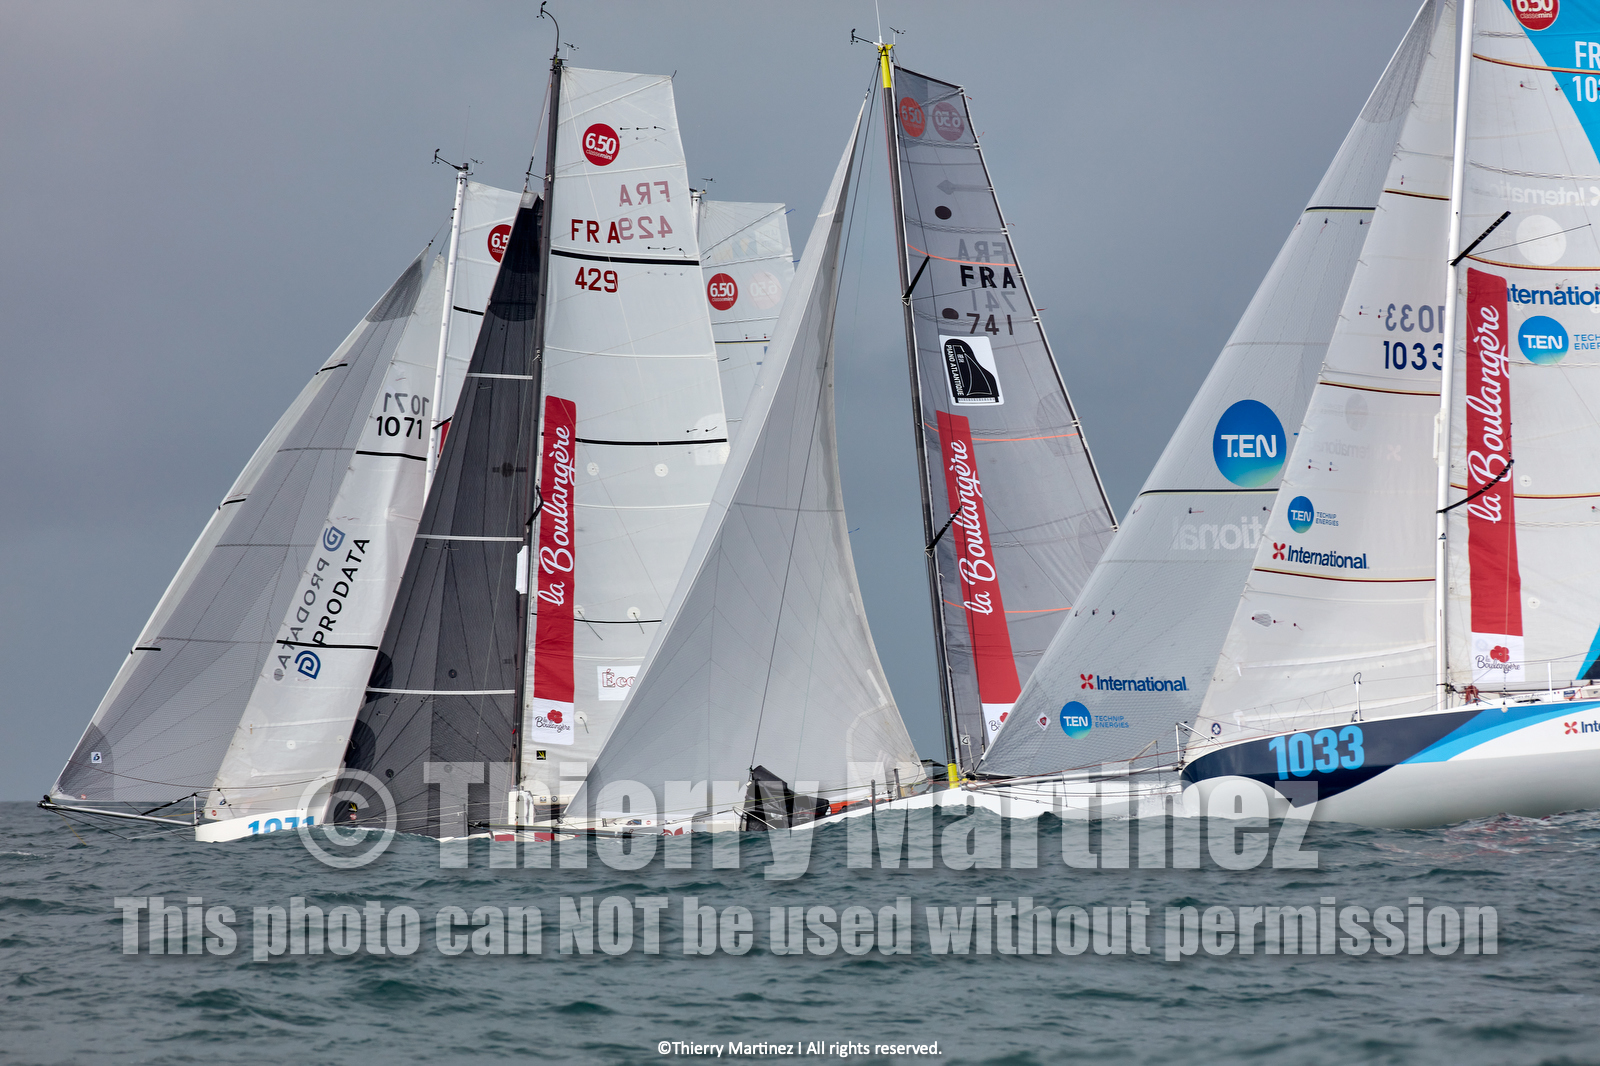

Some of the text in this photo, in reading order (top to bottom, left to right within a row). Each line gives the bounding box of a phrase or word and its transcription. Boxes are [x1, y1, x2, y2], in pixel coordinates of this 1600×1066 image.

[585, 132, 617, 154] 6.50
[571, 219, 621, 243] FRA
[574, 266, 618, 293] 429
[960, 264, 1017, 289] FRA
[710, 282, 735, 297] 6.50
[966, 312, 1014, 336] 741
[1383, 340, 1442, 371] 1033
[376, 416, 422, 440] 1071
[1221, 434, 1277, 458] T.EN
[537, 425, 576, 606] la Boulangère
[1467, 493, 1502, 524] la
[949, 440, 996, 615] la Boulangère
[1287, 545, 1367, 570] International
[312, 539, 370, 646] PRODATA
[1096, 675, 1187, 692] International
[1268, 725, 1365, 781] 1033
